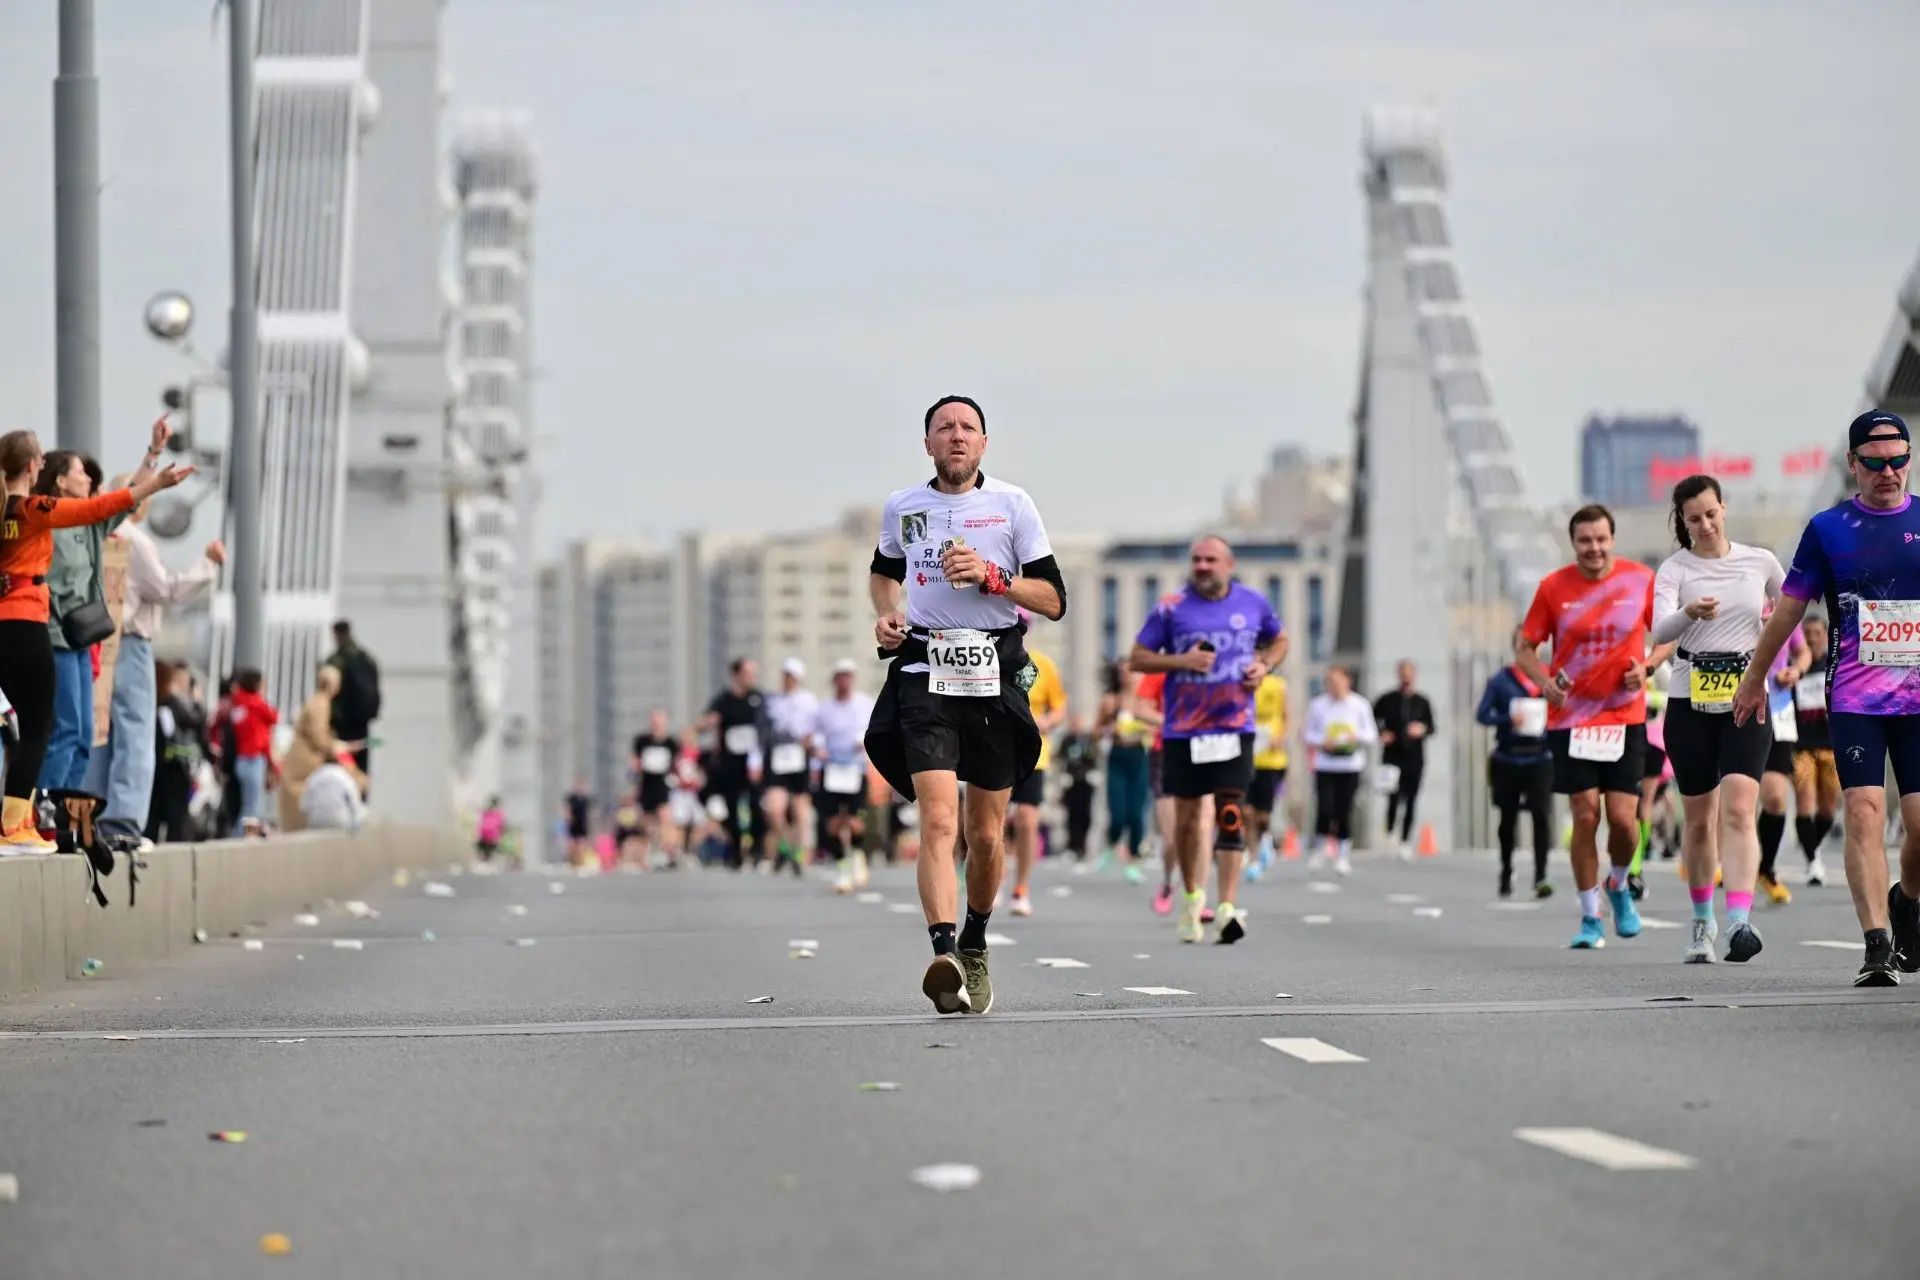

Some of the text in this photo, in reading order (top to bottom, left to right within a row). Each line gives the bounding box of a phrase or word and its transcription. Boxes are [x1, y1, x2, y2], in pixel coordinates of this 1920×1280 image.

[923, 548, 934, 558] Я
[930, 646, 995, 667] 14559
[1867, 651, 1875, 662] J
[1699, 673, 1741, 691] 2941
